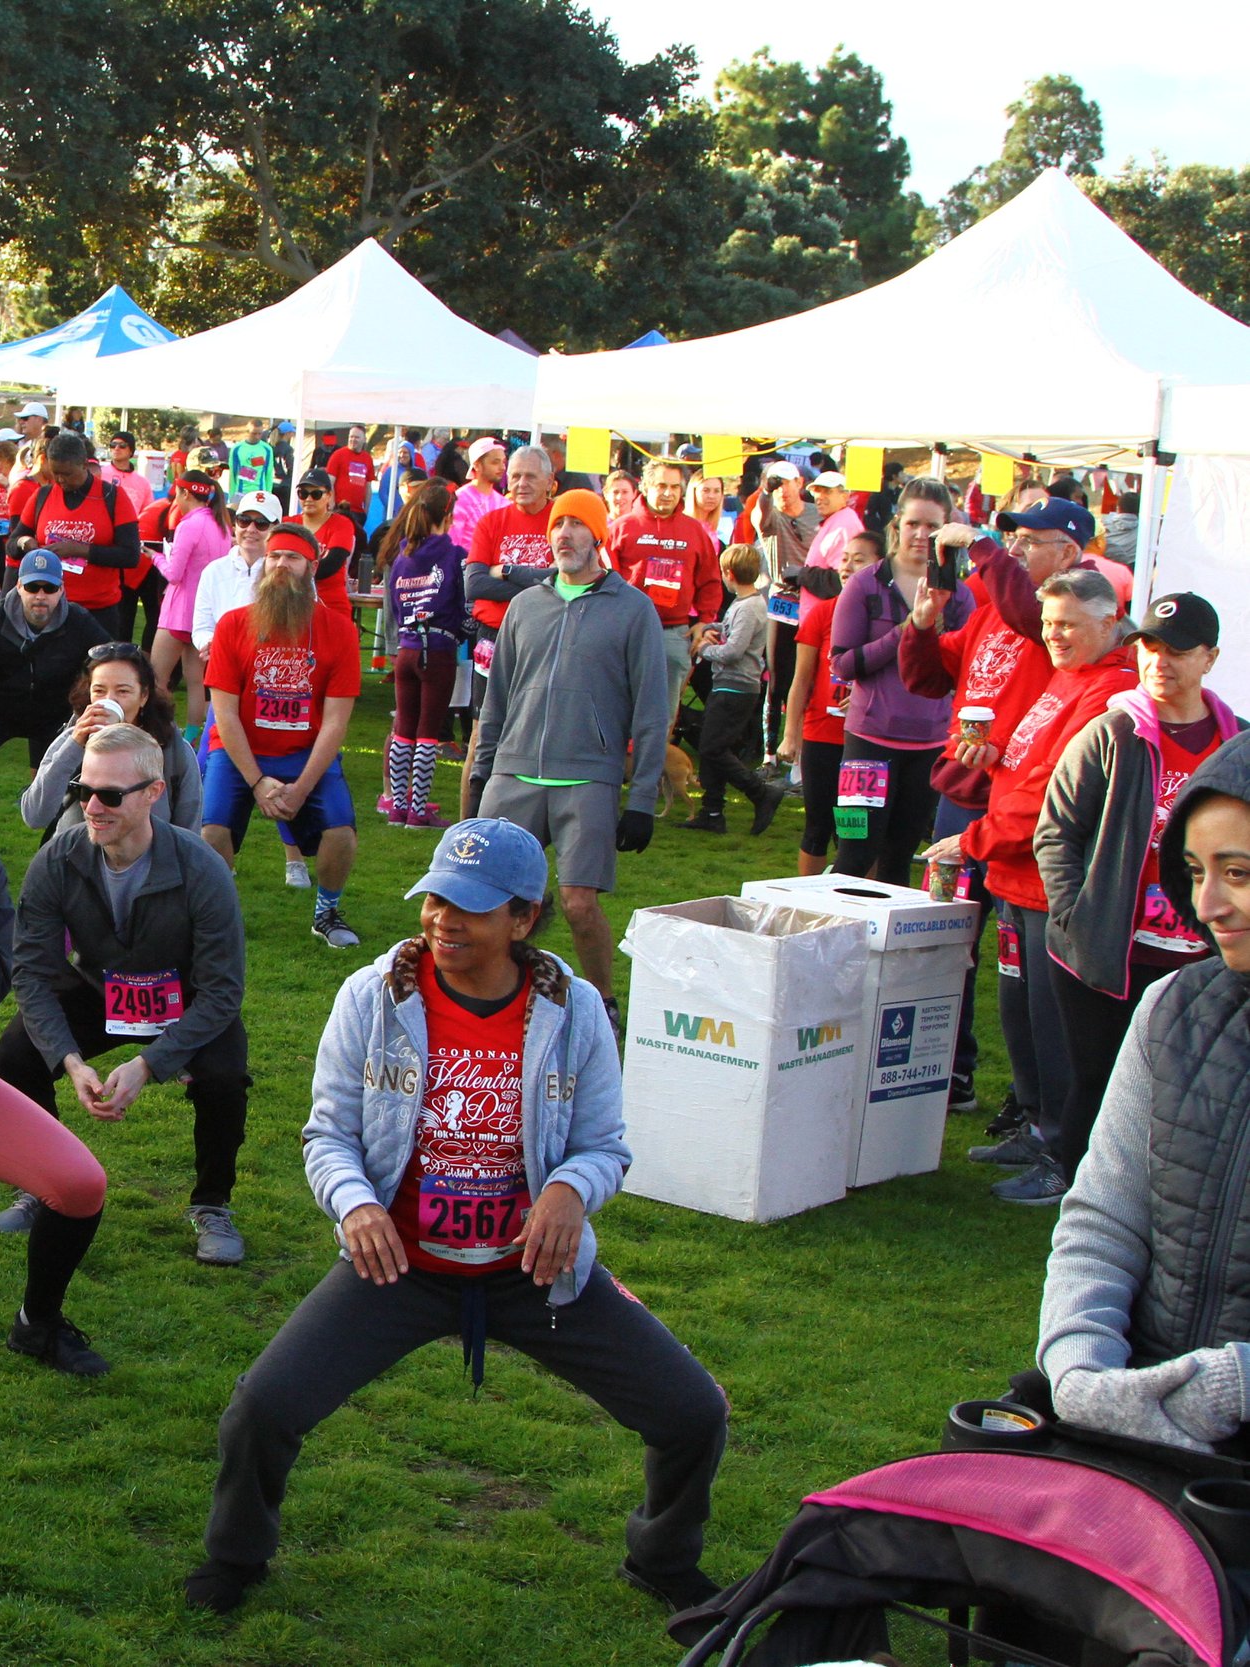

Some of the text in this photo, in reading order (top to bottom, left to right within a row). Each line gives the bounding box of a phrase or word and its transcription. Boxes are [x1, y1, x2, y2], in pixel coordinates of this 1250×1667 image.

[773, 600, 793, 616] 653
[260, 699, 301, 719] 2349
[841, 770, 878, 792] 2752
[1167, 770, 1189, 778] COR
[469, 832, 490, 847] DIEGO
[446, 852, 480, 865] CALIFORNIA
[903, 918, 966, 934] RECYCLABLES ONLY
[111, 985, 167, 1018] 2495
[663, 1009, 736, 1048] WM
[932, 1022, 949, 1031] POWER
[797, 1023, 842, 1051] WM
[880, 1034, 911, 1048] Diamond
[438, 1047, 519, 1061] CORONAD
[636, 1036, 760, 1070] WASTE MANAGEMENT
[778, 1044, 854, 1072] WASTE MANAGEMENT
[364, 1058, 418, 1096] ANG
[880, 1064, 942, 1085] 888-744-7191
[465, 1090, 519, 1124] Day
[433, 1129, 449, 1140] 10k
[453, 1131, 466, 1141] 5k
[478, 1131, 500, 1142] mile
[500, 1133, 516, 1143] run
[428, 1197, 517, 1240] 2567
